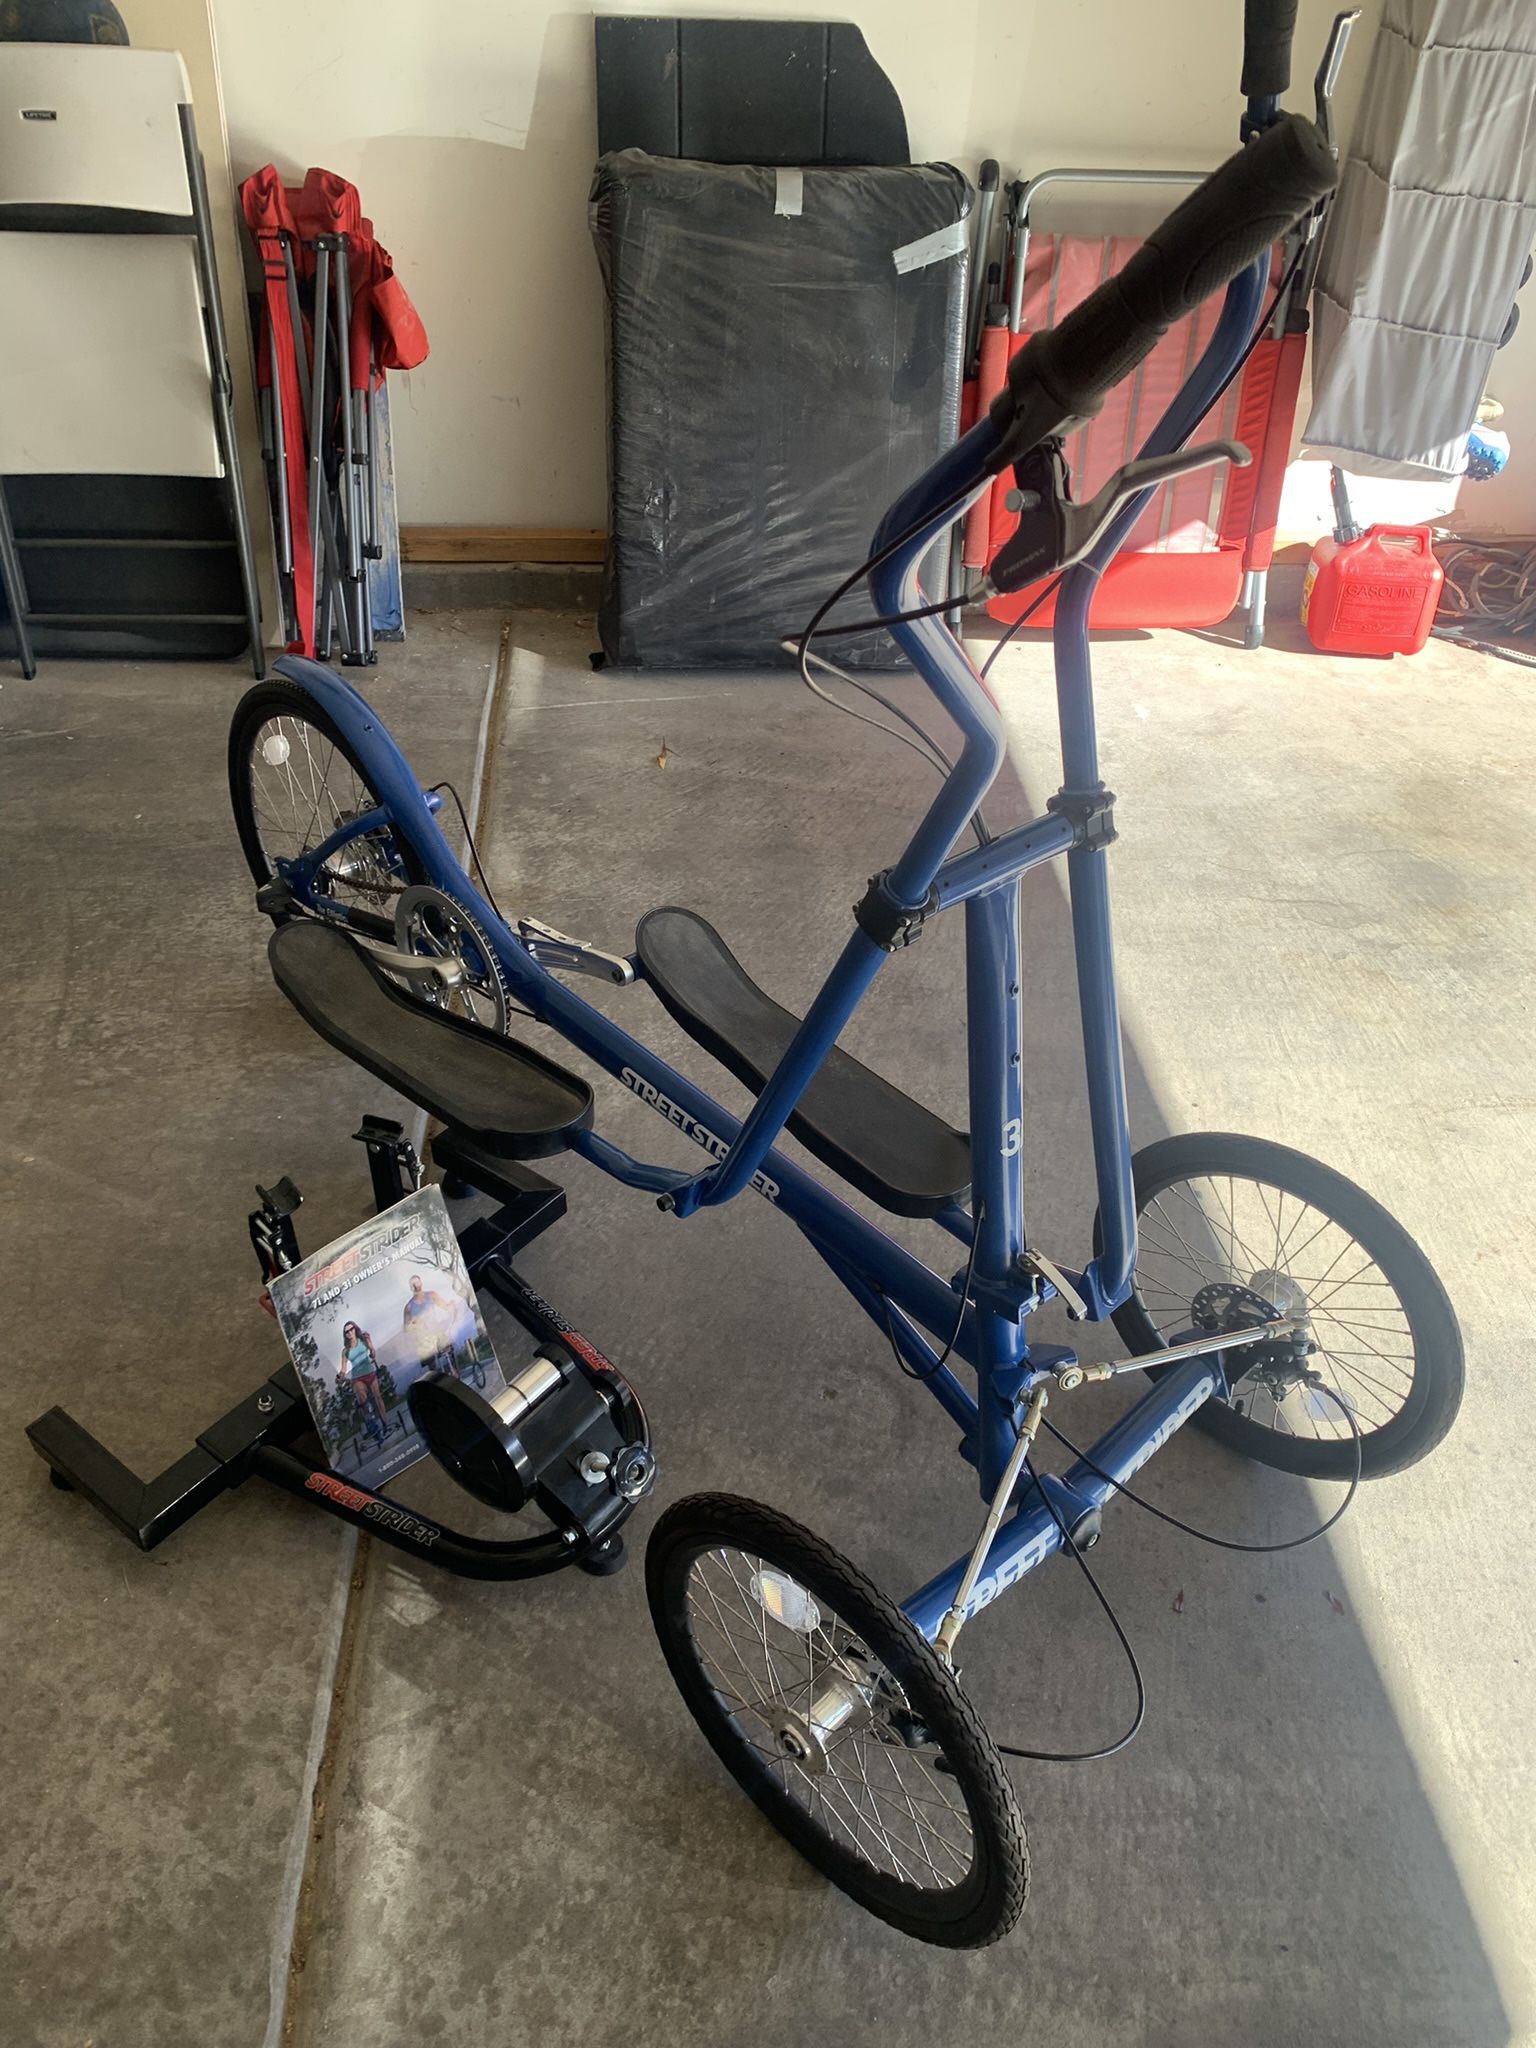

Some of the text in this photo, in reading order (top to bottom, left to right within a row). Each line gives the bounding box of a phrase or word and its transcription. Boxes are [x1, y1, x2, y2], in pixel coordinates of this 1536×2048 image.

[1346, 583, 1424, 600] GASOLINE
[619, 1066, 780, 1203] STREETSTRER
[323, 1286, 341, 1304] AND
[352, 1257, 391, 1284] OWNER'S
[391, 1235, 425, 1263] MANUAL
